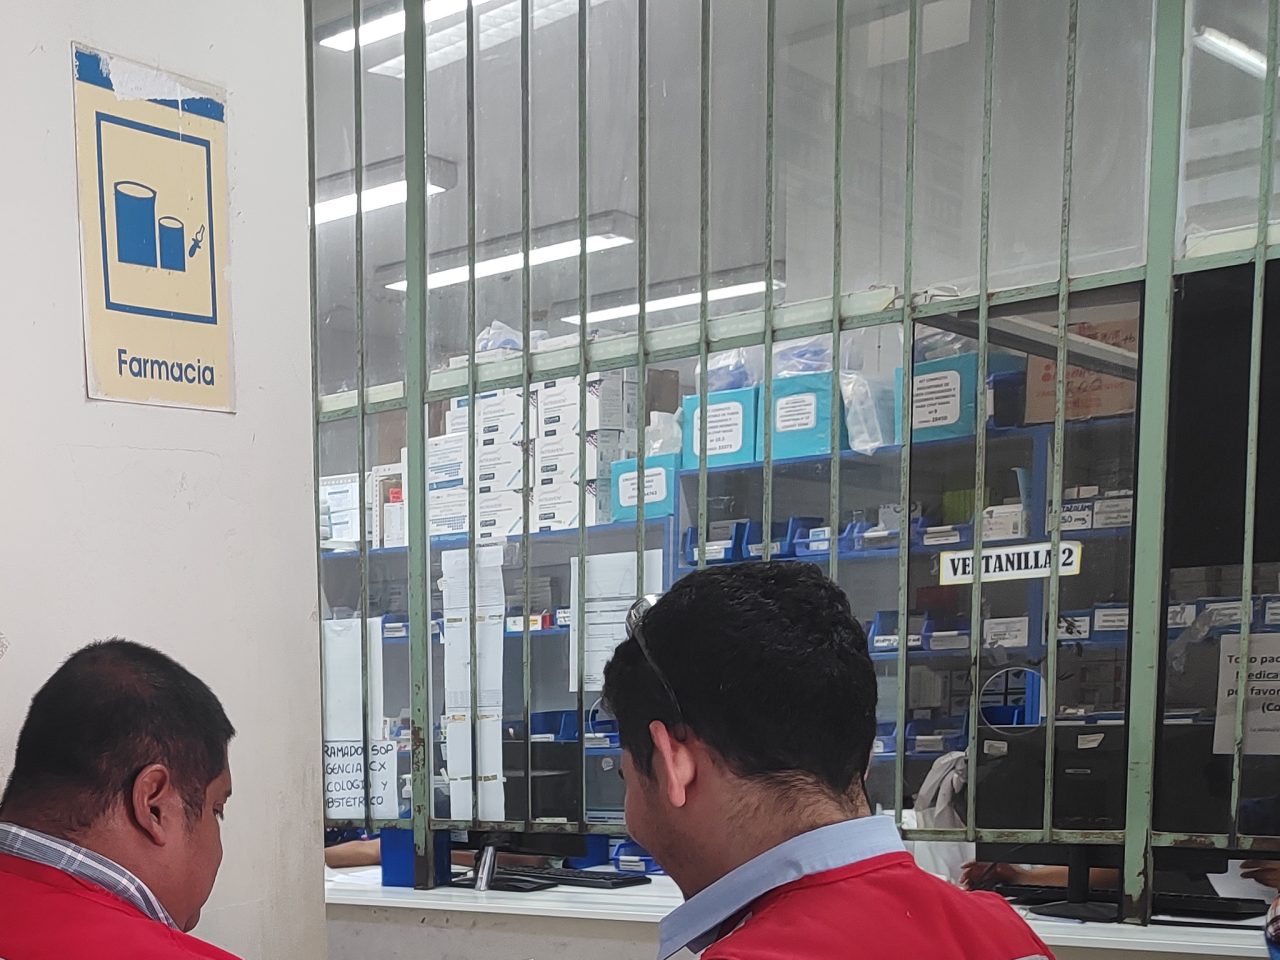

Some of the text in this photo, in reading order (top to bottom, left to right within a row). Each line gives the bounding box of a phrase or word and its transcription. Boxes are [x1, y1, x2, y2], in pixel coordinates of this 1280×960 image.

[117, 348, 215, 386] Farmacia
[950, 547, 1074, 577] VETANILLA 2
[1227, 655, 1257, 664] Too
[371, 744, 394, 756] SOP
[369, 761, 387, 772] CX
[327, 796, 384, 809] BSTETRCO
